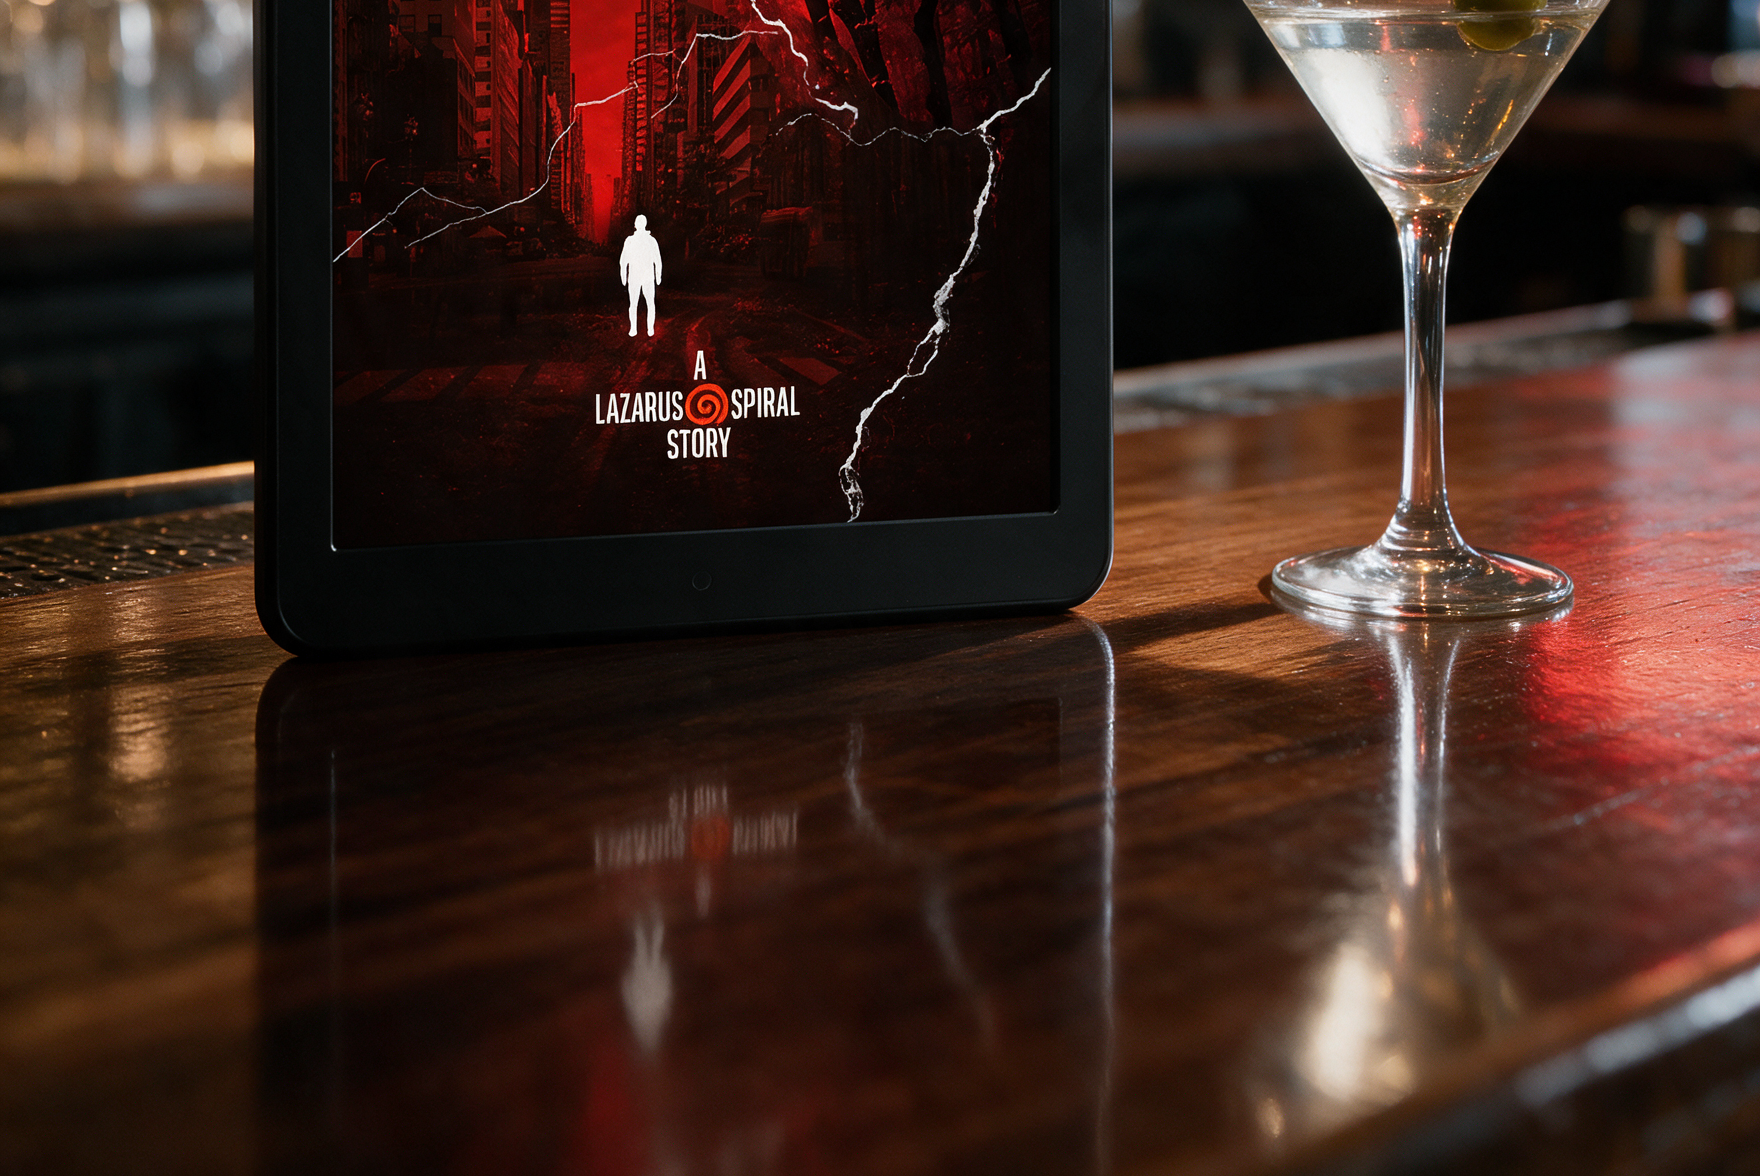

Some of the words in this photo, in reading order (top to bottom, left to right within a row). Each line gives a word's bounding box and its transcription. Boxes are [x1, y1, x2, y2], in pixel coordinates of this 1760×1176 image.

[693, 350, 707, 381] A
[595, 390, 684, 425] LAZARUS
[730, 385, 801, 420] SPIRAL
[666, 427, 731, 460] STORY
